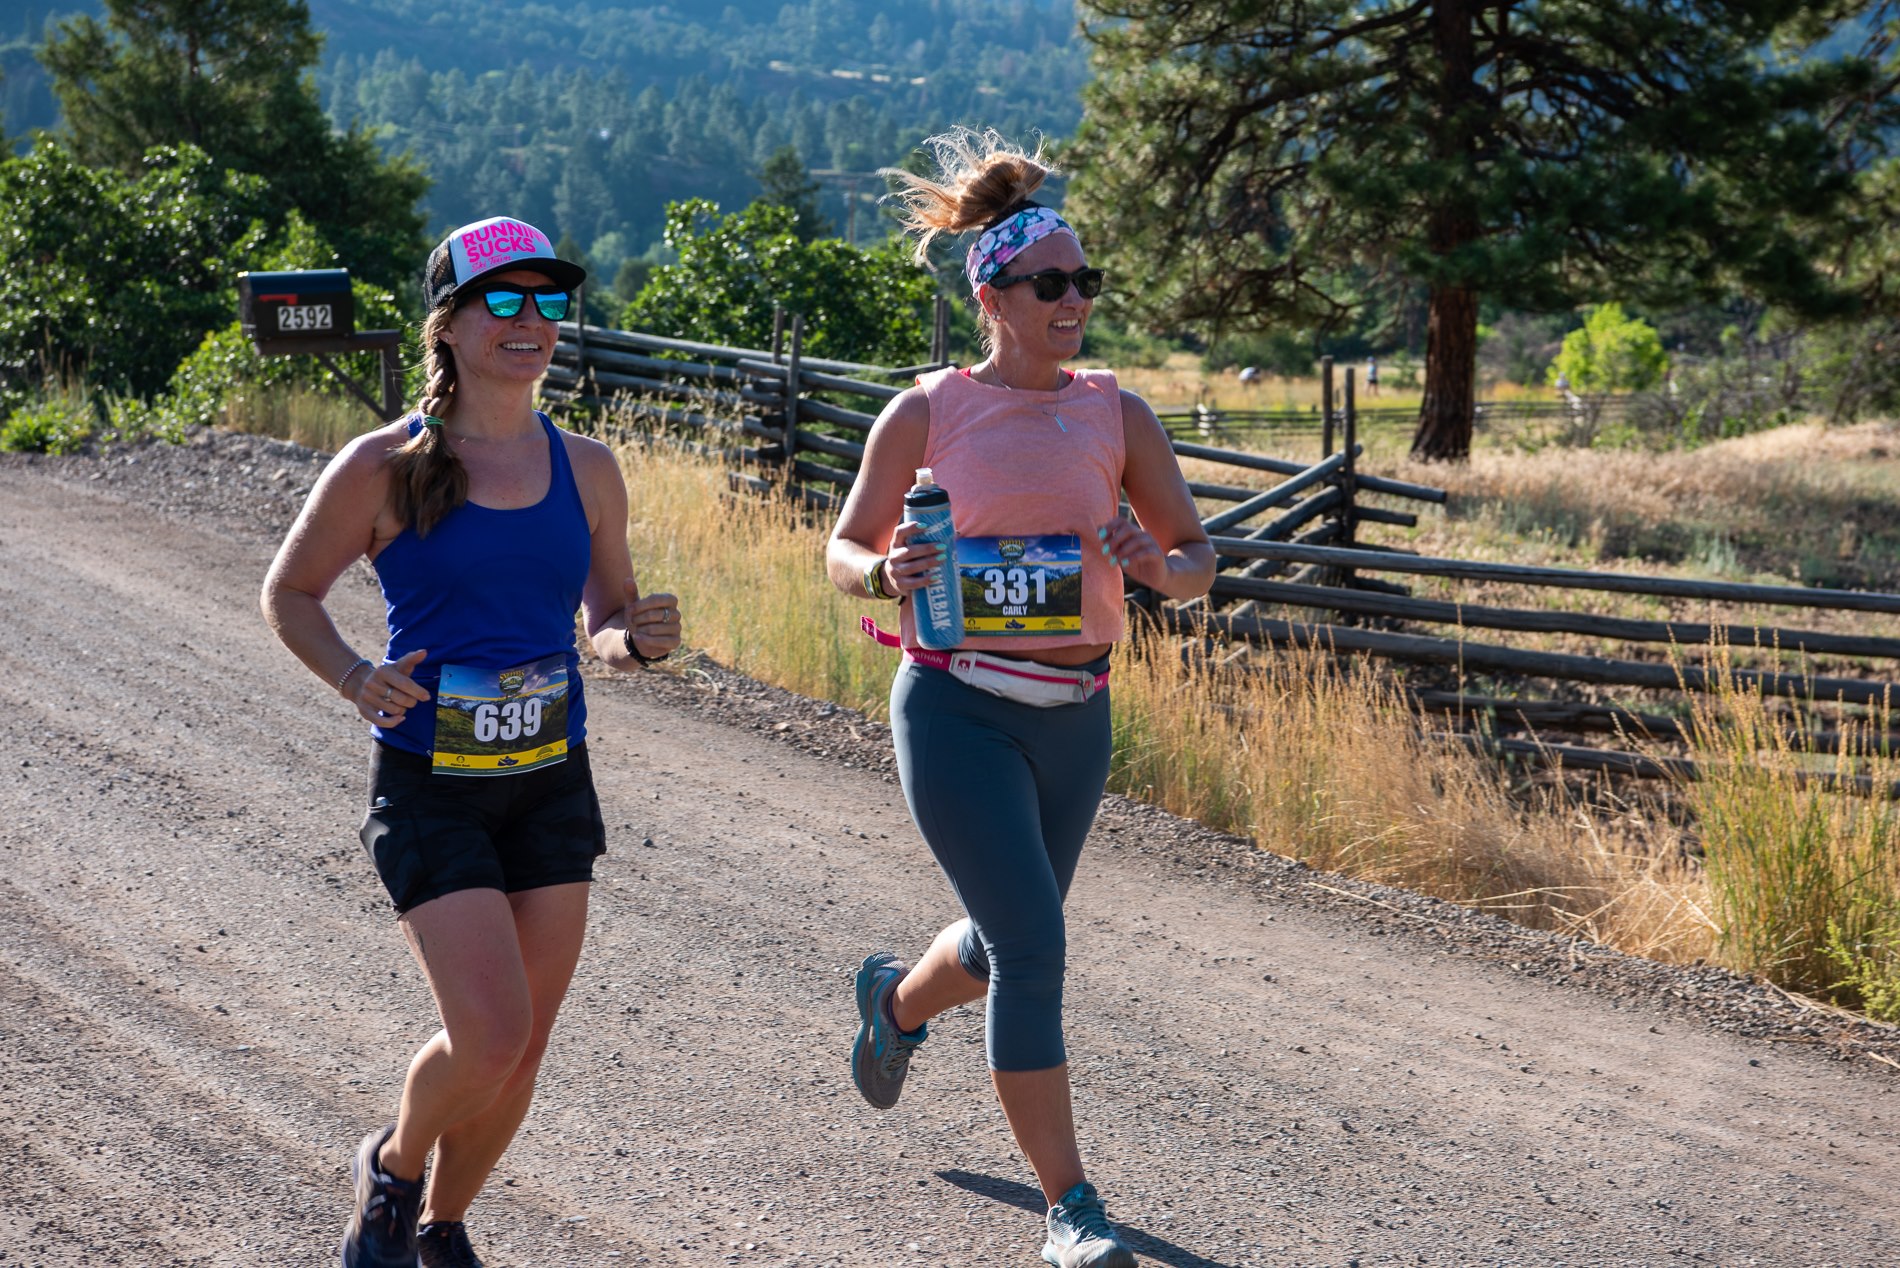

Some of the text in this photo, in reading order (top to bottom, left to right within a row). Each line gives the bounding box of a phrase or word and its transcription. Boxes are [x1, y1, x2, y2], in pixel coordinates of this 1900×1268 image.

[467, 237, 536, 263] SUCKS
[280, 305, 330, 329] 2592
[924, 564, 952, 630] AMELBAK
[984, 568, 1046, 605] 331
[1002, 605, 1028, 616] CARLY
[910, 649, 944, 664] NATHAN
[474, 697, 542, 742] 639
